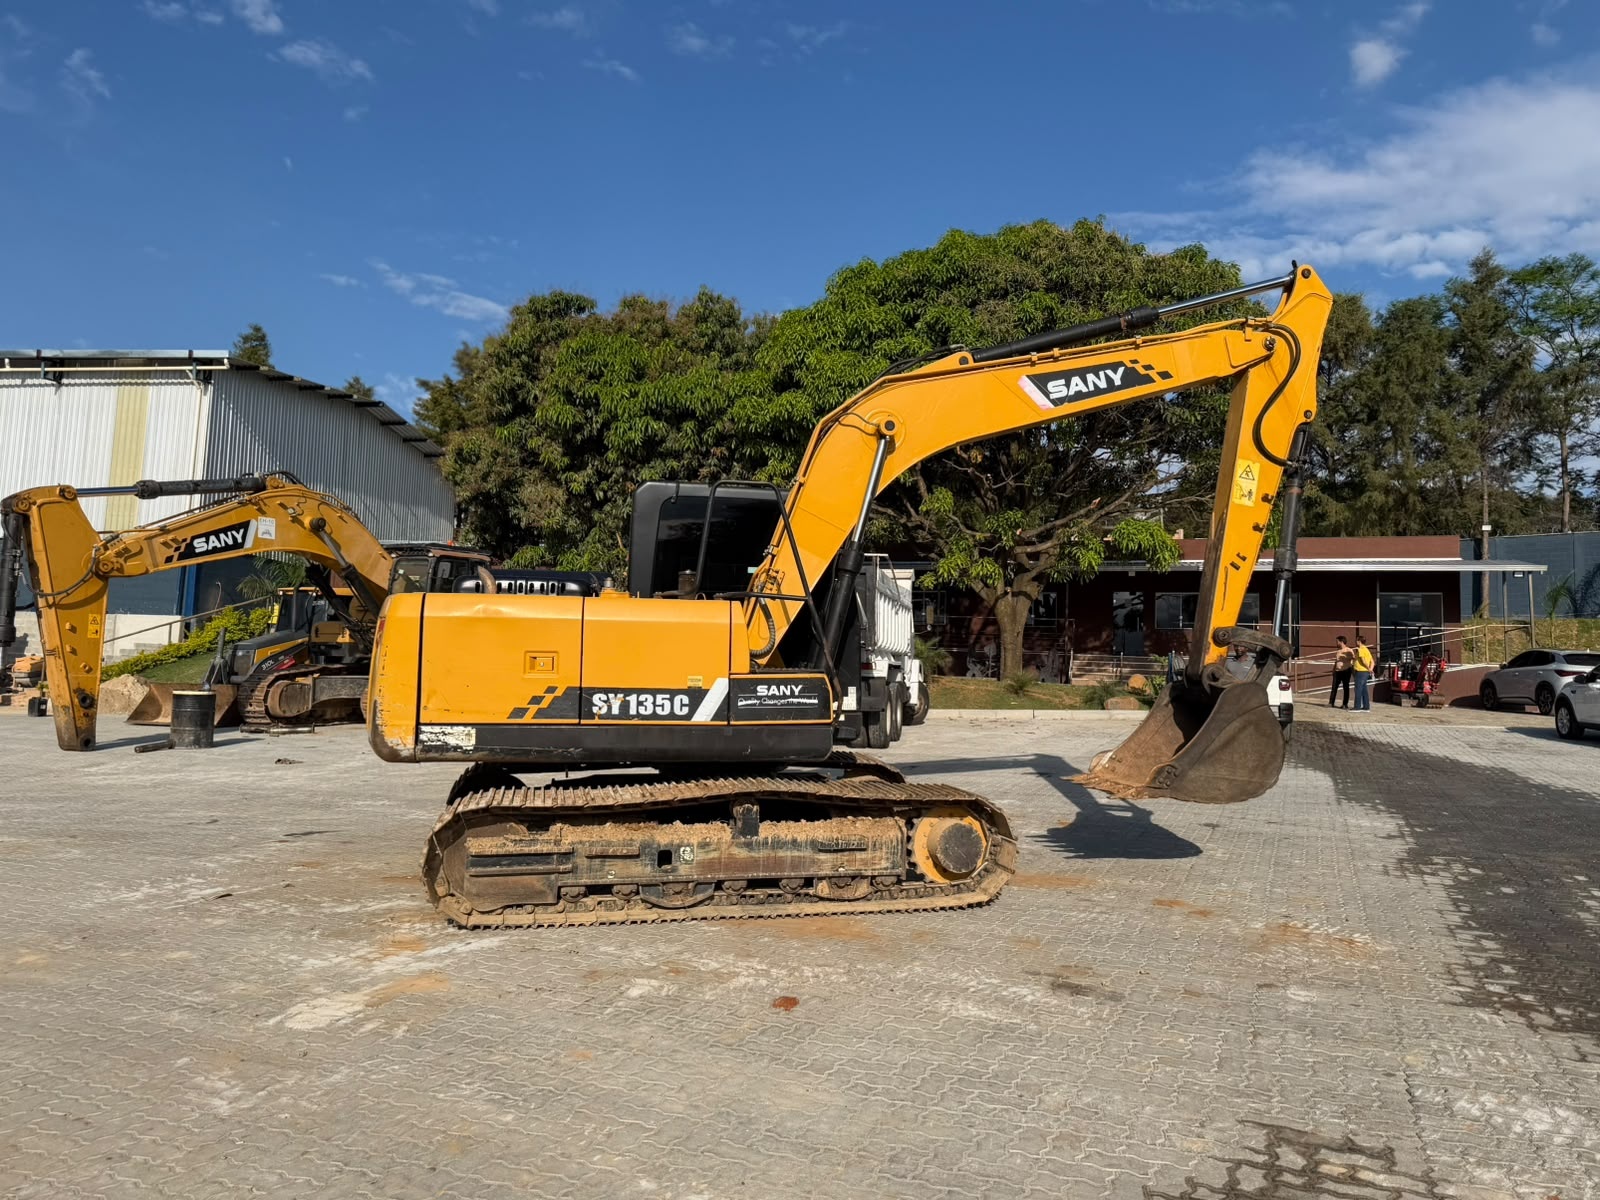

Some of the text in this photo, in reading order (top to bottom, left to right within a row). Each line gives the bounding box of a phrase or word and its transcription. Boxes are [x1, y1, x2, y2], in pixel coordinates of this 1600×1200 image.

[1047, 366, 1126, 400] SANY
[193, 528, 245, 553] SANY
[737, 697, 760, 706] Qlity
[756, 685, 803, 696] SANY
[592, 693, 690, 716] SY135C
